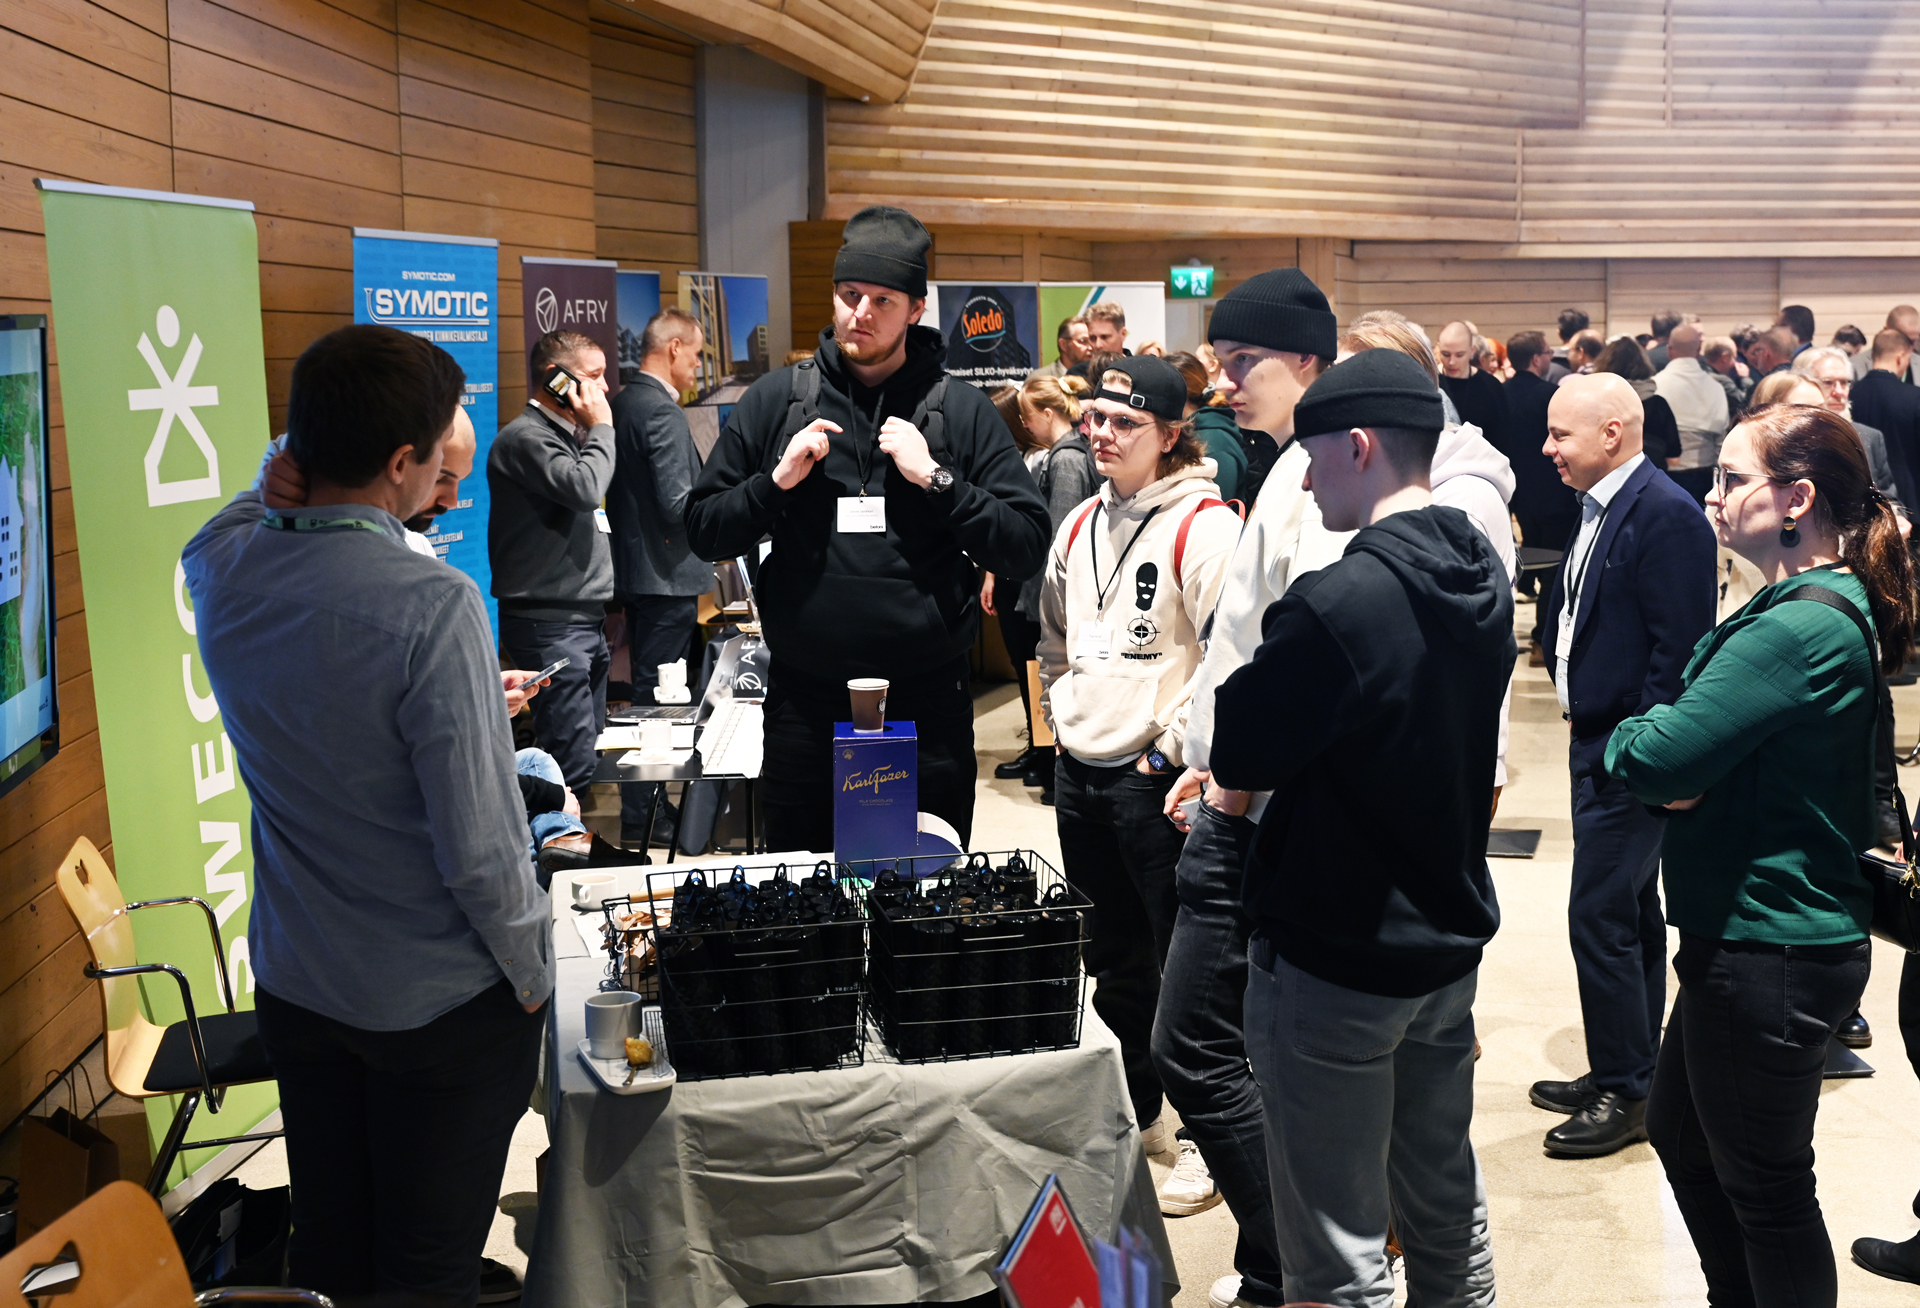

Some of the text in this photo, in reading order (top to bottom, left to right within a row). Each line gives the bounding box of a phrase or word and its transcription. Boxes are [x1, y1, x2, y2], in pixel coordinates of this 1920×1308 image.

[402, 271, 456, 281] SYMOTIC.COM
[376, 288, 488, 317] SYMOTIC
[563, 299, 608, 324] AFRY
[963, 308, 1003, 338] Soledo
[741, 640, 756, 666] AF
[1121, 652, 1162, 660] "ENEMY"
[842, 764, 909, 794] Karl Fazer
